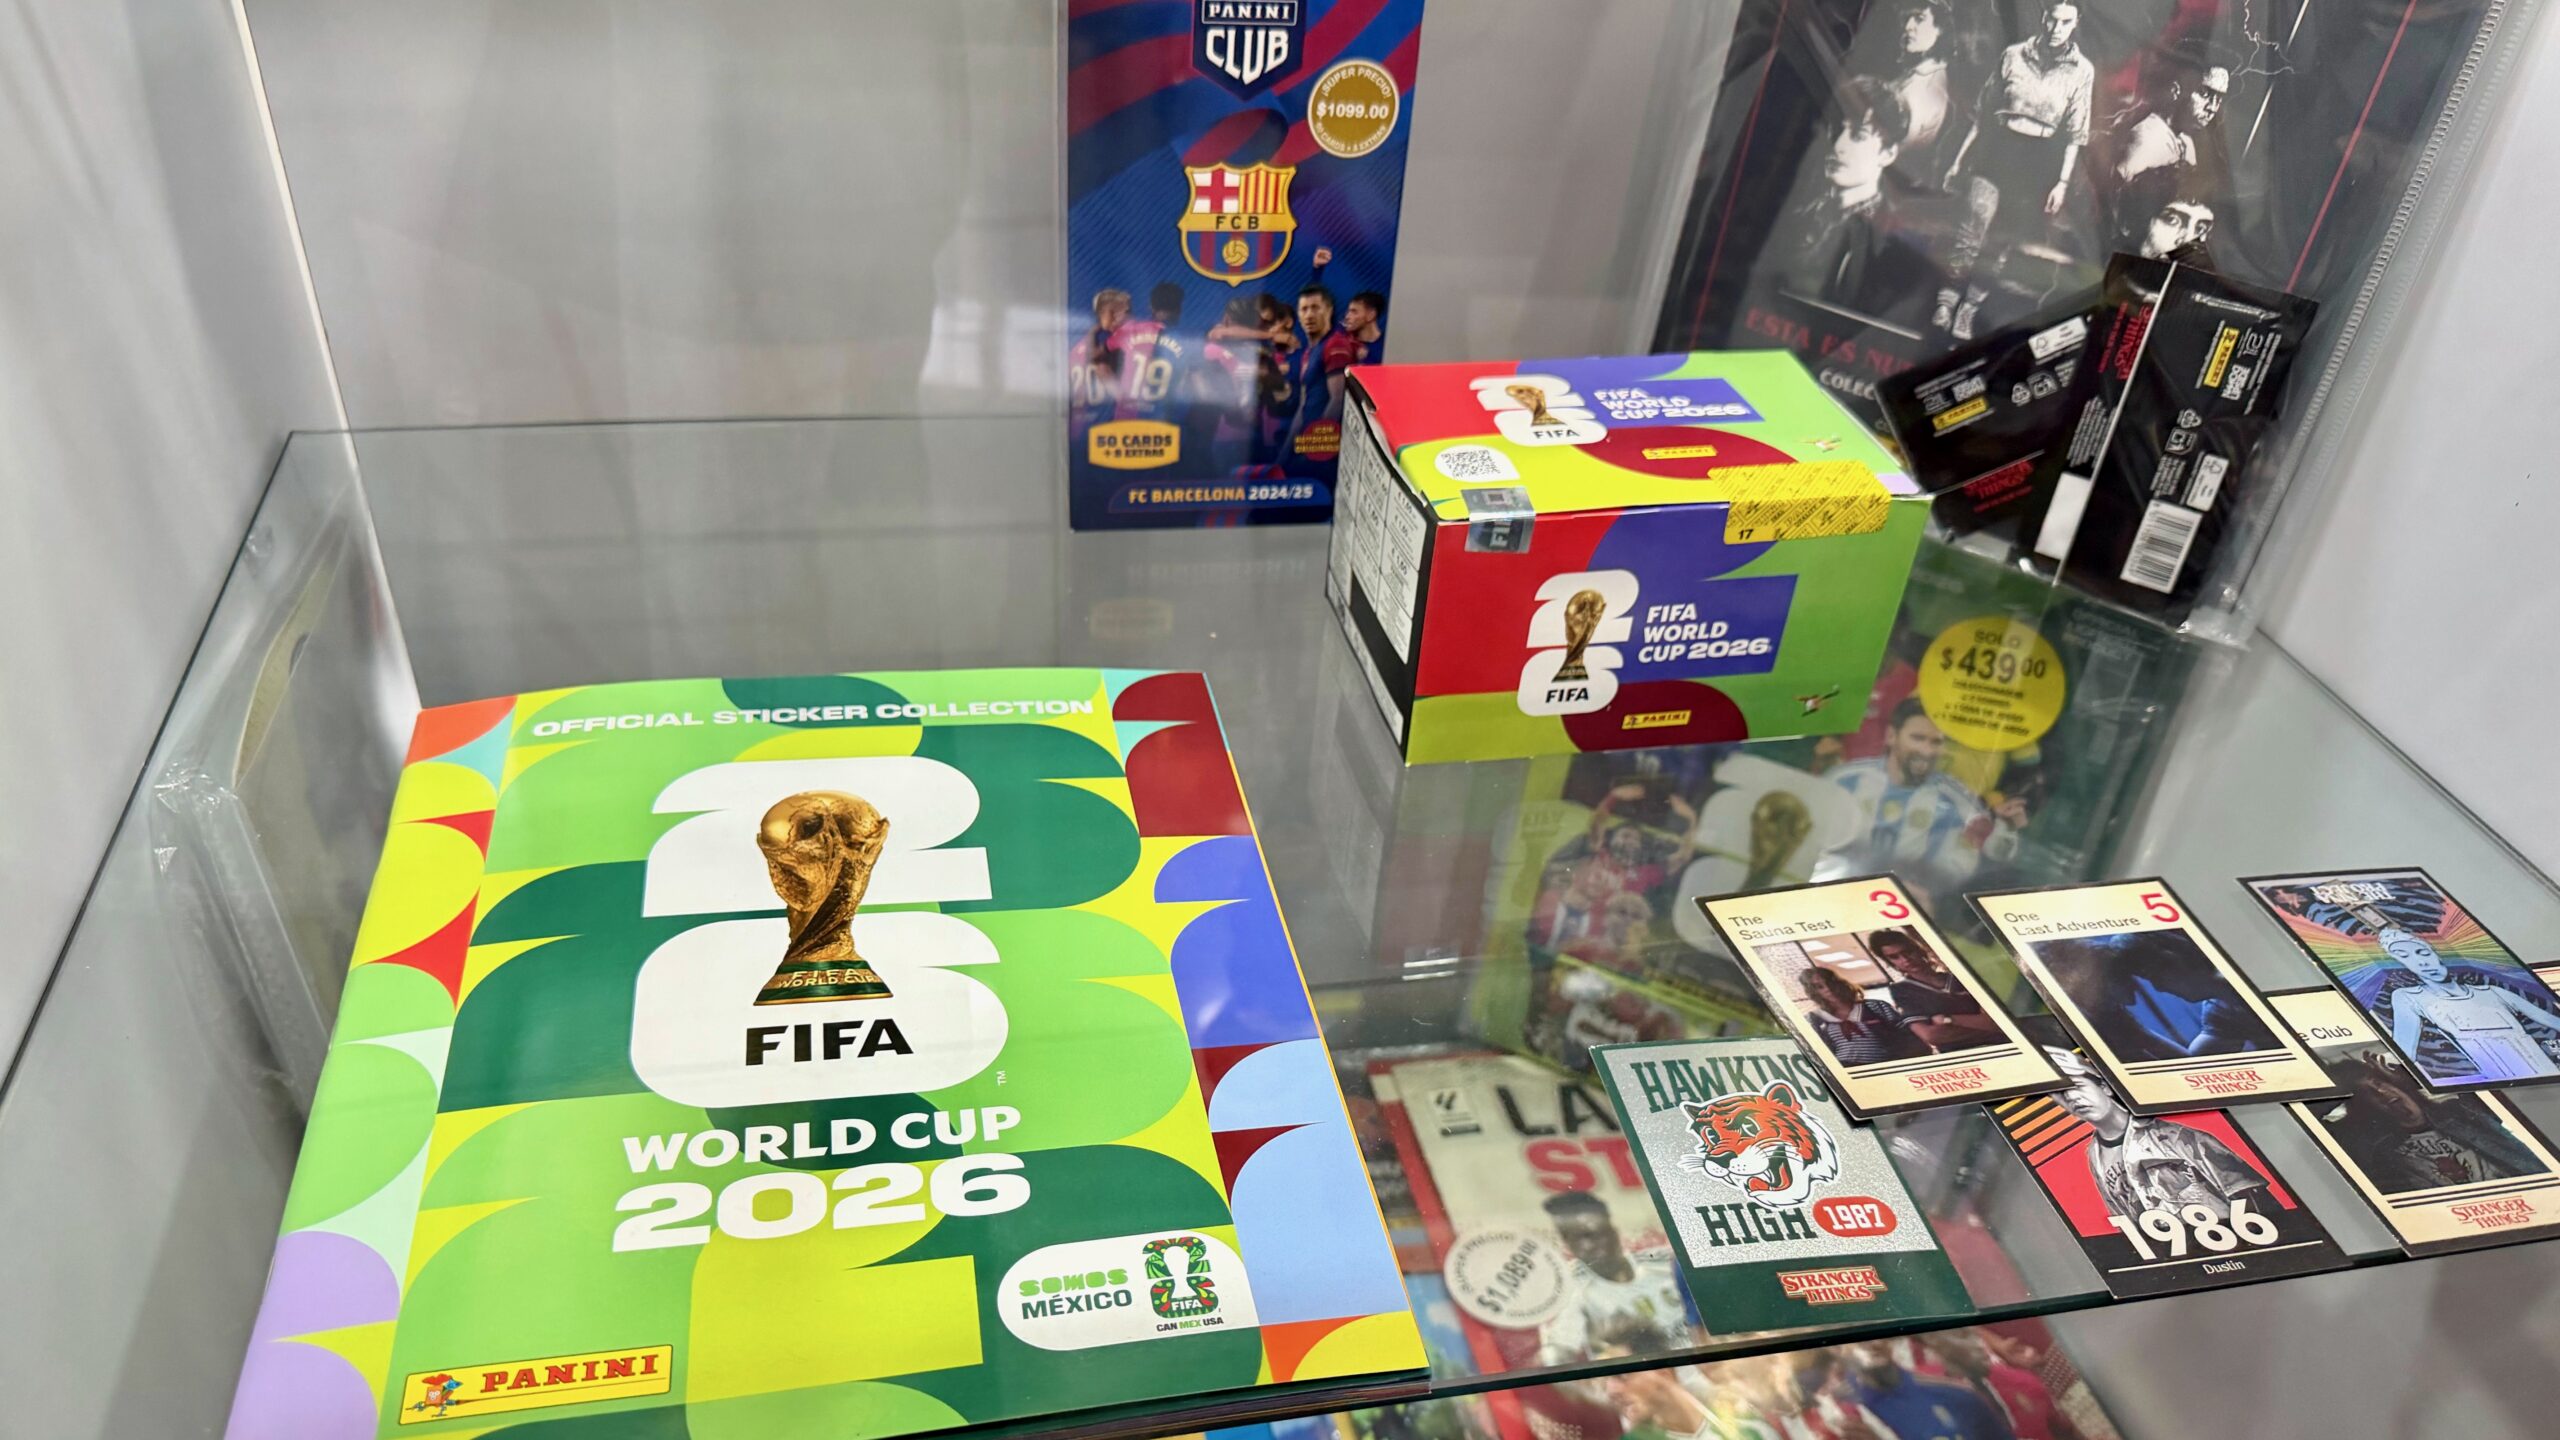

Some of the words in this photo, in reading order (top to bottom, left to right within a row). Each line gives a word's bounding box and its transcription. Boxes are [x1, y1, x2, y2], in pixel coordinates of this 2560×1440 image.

[1208, 3, 1290, 20] PANINI
[1205, 28, 1289, 85] CLUB
[1316, 100, 1389, 120] $1099.00
[1745, 307, 1811, 349] ESTA
[1820, 334, 1857, 364] ES
[1820, 367, 1875, 400] COLEC
[1594, 388, 1647, 400] FIFA
[1601, 396, 1691, 409] WORLD
[1611, 408, 1659, 420] CUP
[1662, 403, 1747, 417] 2026
[1122, 435, 1172, 447] CARDS
[1533, 429, 1580, 439] FIFA
[1129, 489, 1147, 503] FC
[1152, 486, 1245, 502] BARCELONA
[1250, 484, 1313, 500] 2024/25
[1738, 529, 1754, 540] 17
[1646, 603, 1697, 624] FIFA
[1644, 621, 1729, 643] WORLD
[1638, 644, 1686, 664] CUP
[1687, 637, 1770, 660] 2026
[1545, 687, 1589, 703] FIFA
[532, 711, 705, 738] OFFICIAL
[712, 703, 869, 725] STICKER
[875, 699, 1094, 721] COLLECTION
[1643, 713, 1687, 723] PANINI
[1869, 890, 1910, 920] 3
[2140, 893, 2180, 923] 5
[1728, 915, 1763, 928] The
[2003, 912, 2040, 923] One
[2012, 923, 2053, 936] Last
[2056, 916, 2141, 931] Adventure
[1739, 926, 1795, 941] Sauna
[1795, 919, 1836, 933] Test
[778, 977, 839, 988] WORLD
[844, 974, 876, 984] CUP
[791, 968, 861, 979] FIFA
[745, 1018, 914, 1066] FIFA
[2311, 1026, 2353, 1039] Club
[1630, 1053, 1830, 1114] HAWKINS
[1908, 1067, 1989, 1089] STRANGER
[1926, 1080, 1983, 1094] THINGS
[2184, 1070, 2264, 1088] STRANGER
[2204, 1081, 2258, 1094] THINGS
[623, 1117, 877, 1174] WORLD
[890, 1105, 1021, 1149] CUP
[612, 1153, 1031, 1253] 2026
[2451, 1198, 2534, 1221] STRANGER
[1694, 1203, 1818, 1247] HIGH
[1822, 1204, 1886, 1230] 1987
[2472, 1212, 2530, 1228] THINGS
[2108, 1200, 2278, 1261] 1986
[2202, 1259, 2245, 1276] Dustin
[1018, 1268, 1129, 1297] SOMOS
[1780, 1268, 1886, 1294] STRANGER
[1803, 1283, 1874, 1303] THINGS
[1021, 1288, 1133, 1320] MÉXICO
[1171, 1299, 1202, 1311] FIFA
[1156, 1322, 1178, 1332] CAN
[1179, 1320, 1201, 1329] MEX
[1203, 1316, 1224, 1326] USA
[480, 1354, 659, 1393] PANINI
